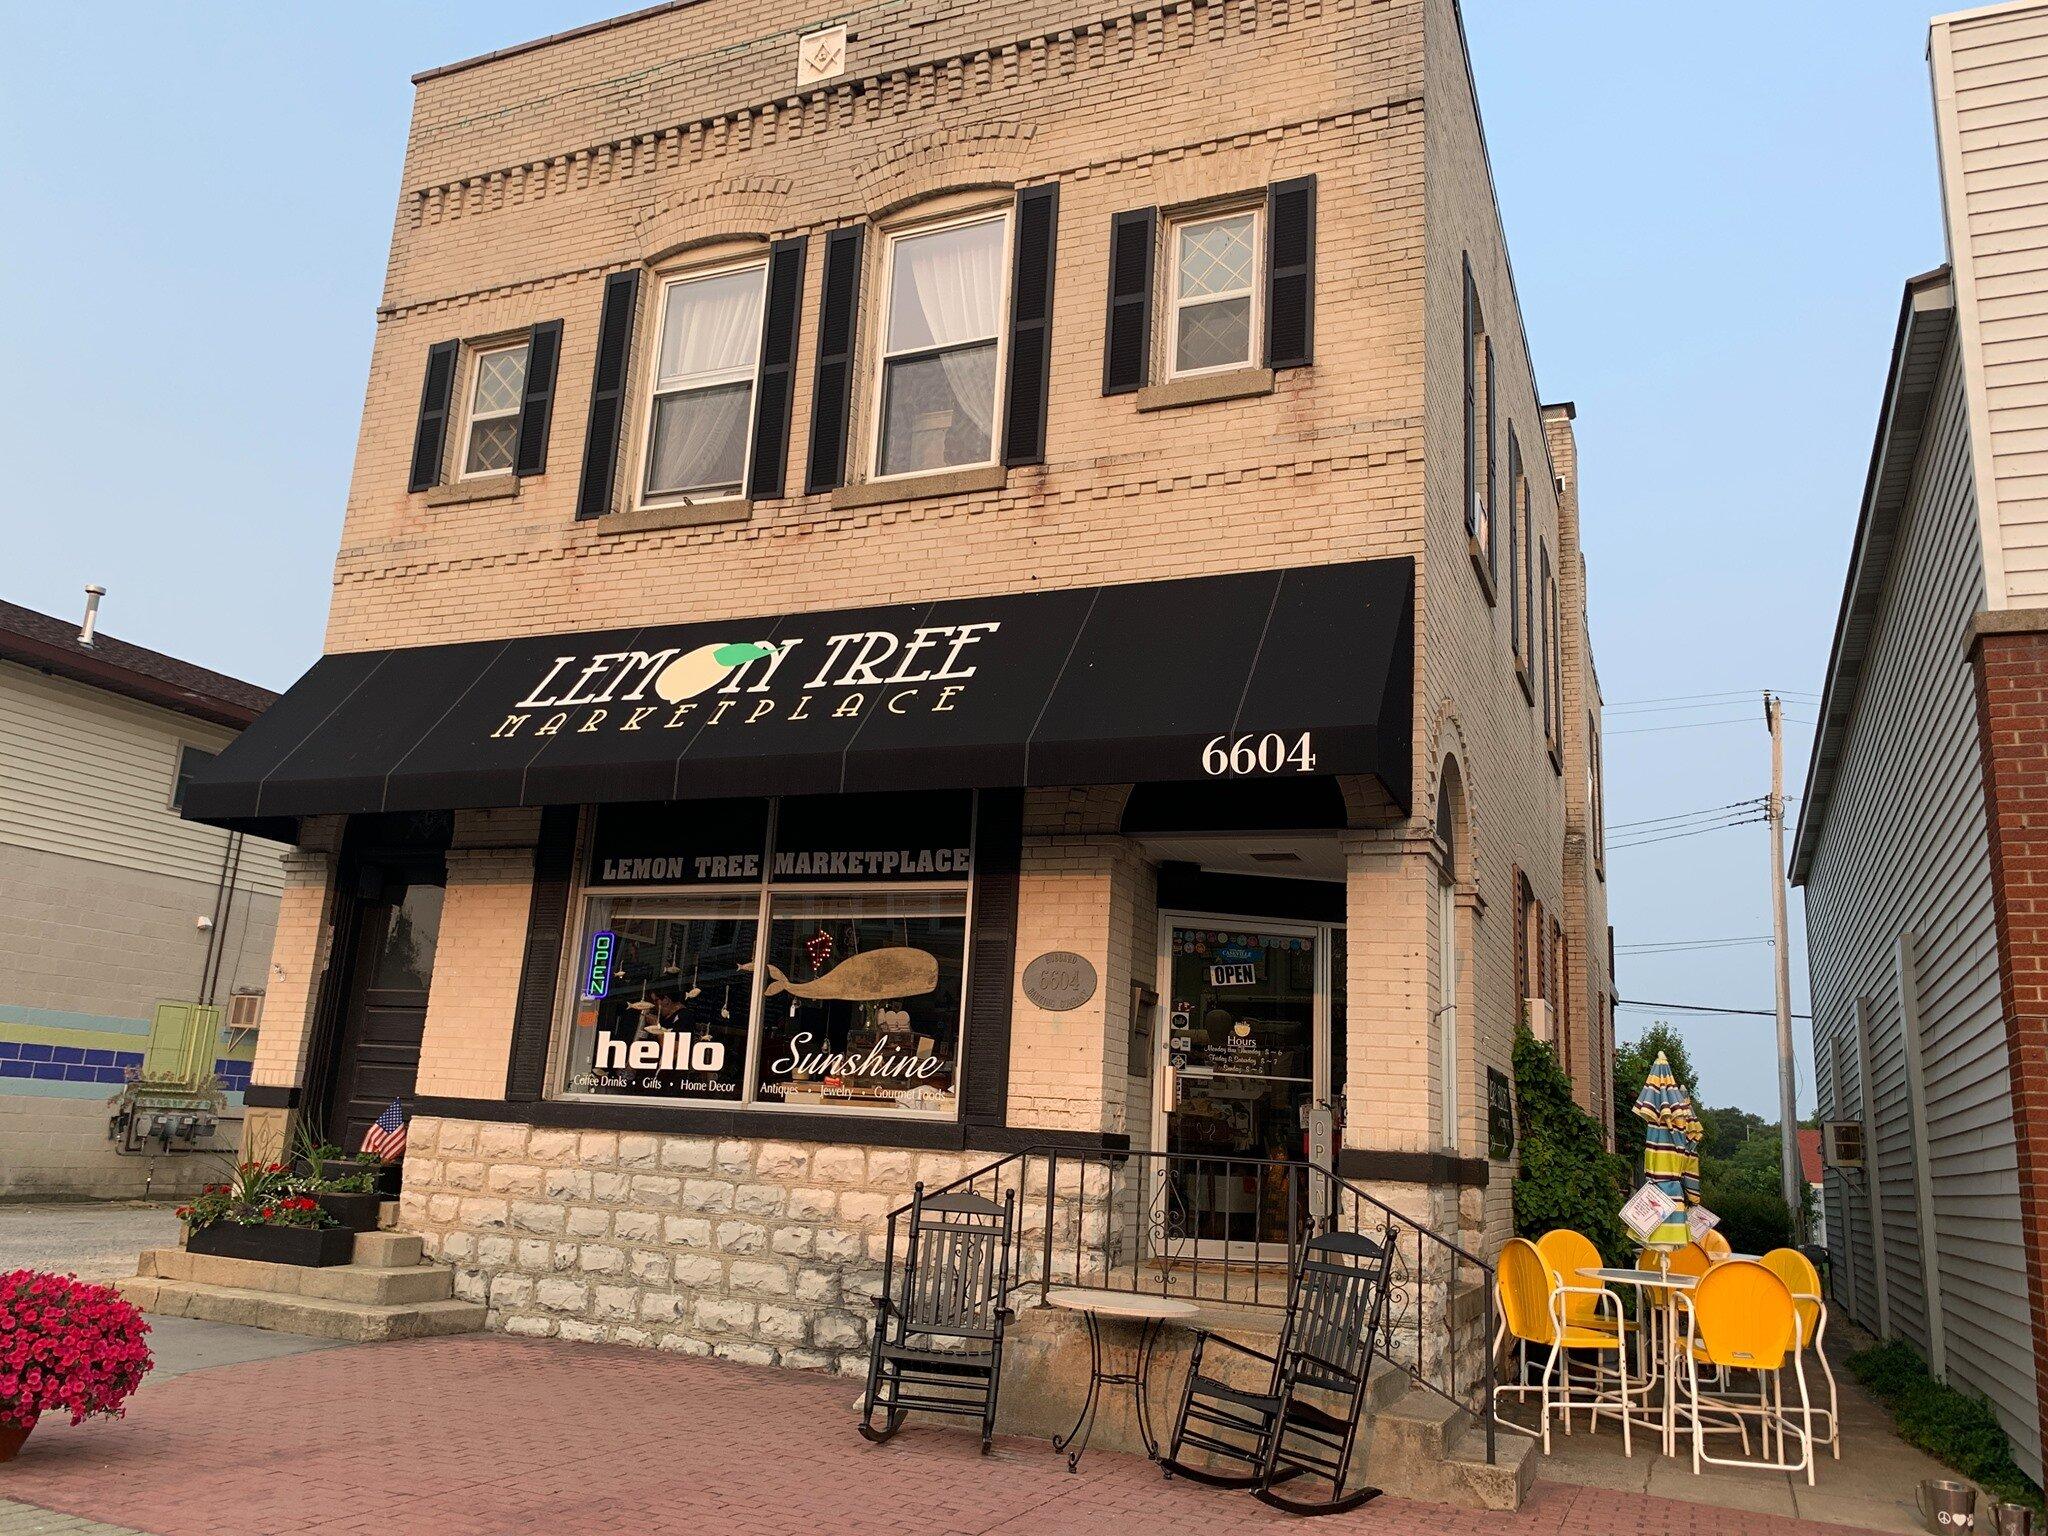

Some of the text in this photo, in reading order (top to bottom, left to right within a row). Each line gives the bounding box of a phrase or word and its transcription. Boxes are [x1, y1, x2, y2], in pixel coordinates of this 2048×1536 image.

[803, 621, 1001, 689] TREE
[491, 685, 965, 738] MARKETPLACE
[1202, 731, 1316, 776] 6604
[603, 848, 970, 880] LEMON TREE MARKETPLACE
[590, 936, 611, 995] OPEN
[1040, 970, 1079, 991] 6604
[1214, 966, 1253, 984] OPEN
[595, 1031, 725, 1071] hello
[771, 1031, 946, 1079] Sunshine
[1227, 1036, 1257, 1047] Hours
[573, 1074, 736, 1093] Coffee Drinks Gifts Home Decor
[760, 1083, 946, 1100] Antiques Jewelry Gourmet Foods
[1315, 1121, 1324, 1205] OPEN
